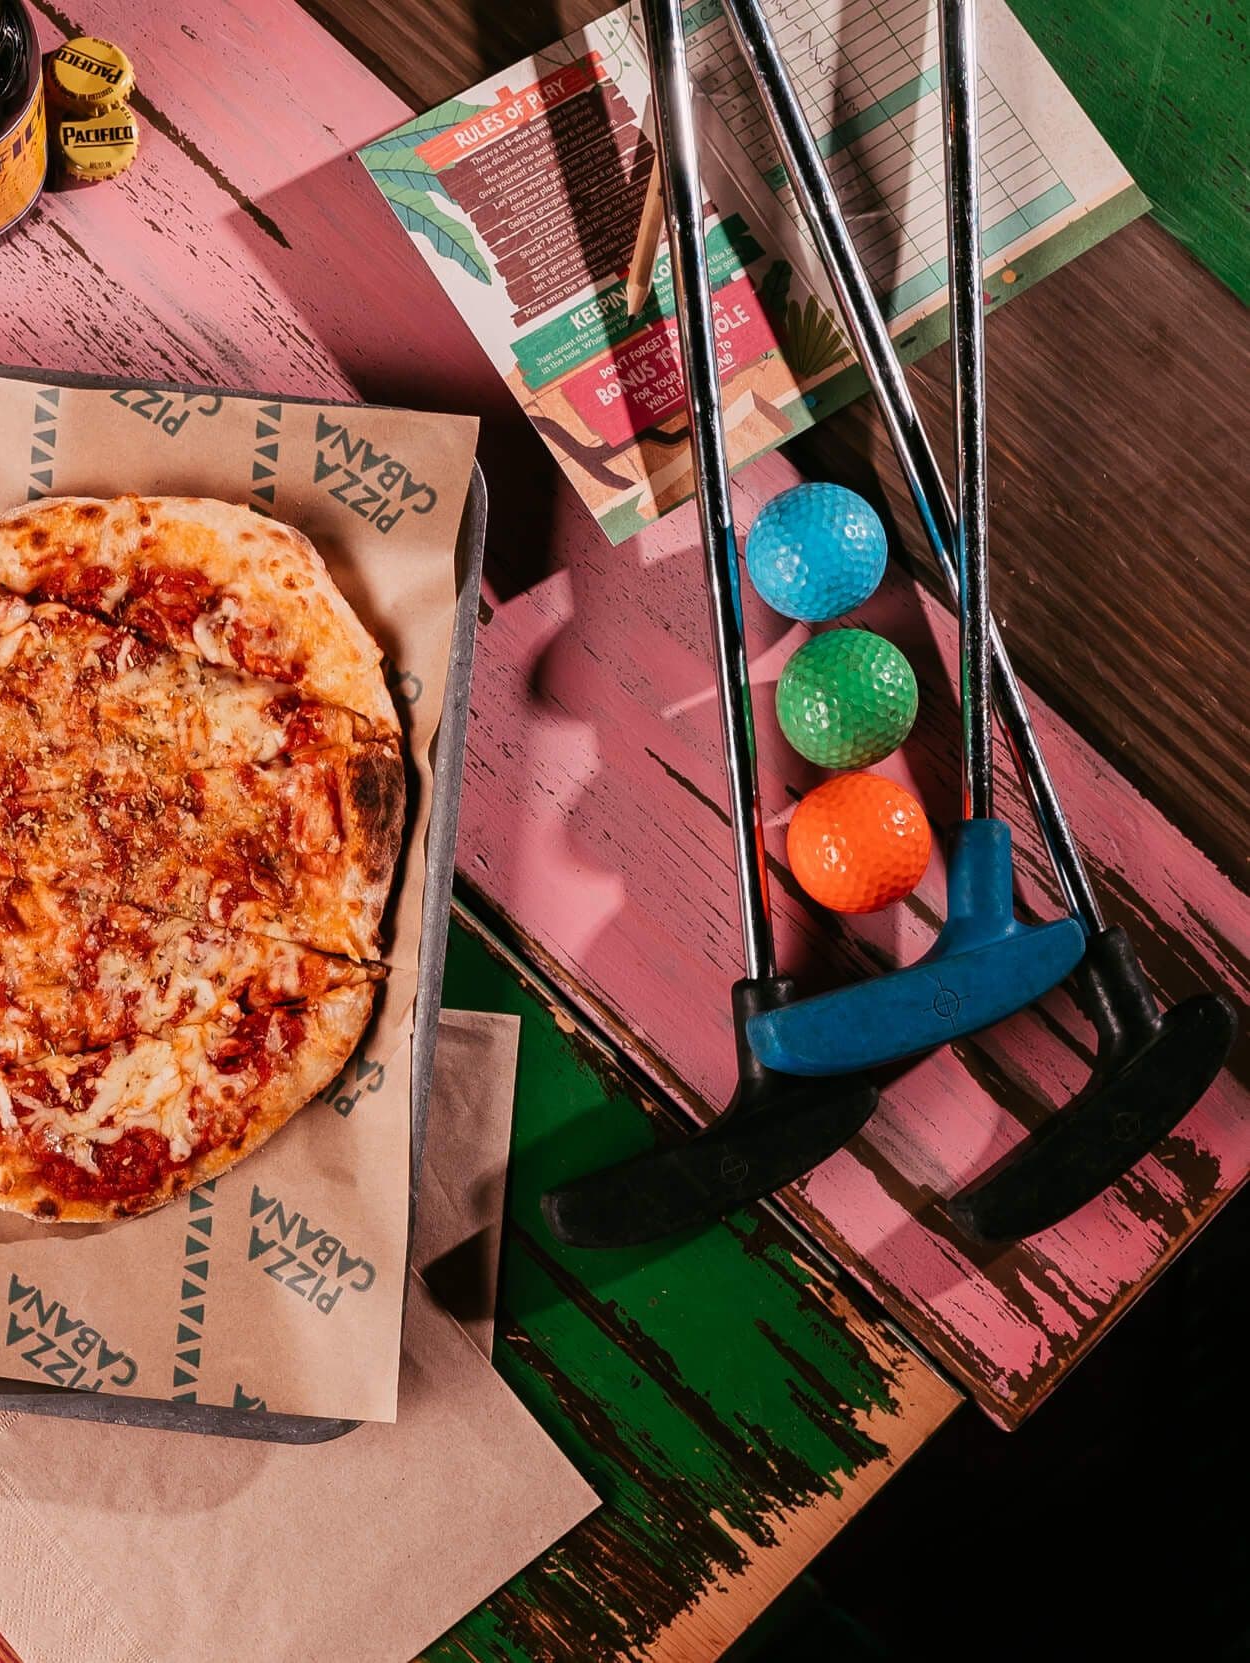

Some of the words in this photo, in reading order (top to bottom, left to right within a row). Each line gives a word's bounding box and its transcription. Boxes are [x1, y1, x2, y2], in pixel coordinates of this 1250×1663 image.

[453, 110, 506, 150] RULES
[502, 99, 526, 122] OF
[525, 76, 568, 109] PLAY
[528, 117, 549, 133] limit
[62, 126, 134, 145] PACIFICO
[475, 161, 493, 177] you
[509, 140, 529, 155] hold
[526, 134, 541, 148] up
[483, 171, 500, 185] Not
[497, 158, 521, 177] holed
[518, 150, 535, 165] the
[532, 142, 551, 157] ball
[476, 183, 498, 200] Give
[494, 166, 529, 192] yourself
[533, 152, 556, 169] score
[491, 196, 509, 211] Let
[506, 187, 526, 204] your
[523, 173, 549, 192] whole
[506, 209, 538, 232] Golfing
[533, 193, 565, 217] groups
[508, 190, 541, 214] anyone
[537, 177, 563, 198] plays
[517, 238, 547, 260] Stuck?
[544, 226, 568, 244] Move
[527, 220, 550, 237] Love
[547, 211, 568, 228] your
[527, 251, 548, 267] (one
[545, 237, 572, 258] putter
[530, 267, 550, 283] Ball
[547, 258, 570, 276] gone
[531, 279, 548, 294] left
[545, 272, 561, 286] the
[558, 258, 587, 279] course
[522, 299, 547, 318] Move
[544, 289, 565, 305] onto
[561, 281, 578, 295] the
[568, 285, 631, 331] KEEPIN
[707, 302, 752, 339] OLE
[533, 350, 554, 367] Just
[551, 337, 576, 356] count
[574, 329, 590, 343] the
[597, 355, 630, 380] DON'T
[627, 334, 666, 361] FORGET
[663, 324, 680, 340] TO
[716, 337, 734, 354] TO
[538, 364, 551, 375] in
[547, 355, 564, 370] the
[592, 357, 660, 407] BONUS
[631, 384, 654, 404] FOR
[650, 368, 681, 391] YOUR
[644, 391, 669, 411] WIN
[110, 389, 191, 437] PIZZ
[315, 413, 439, 516] CABANA
[312, 451, 401, 534] PIZZA
[250, 1184, 376, 1294] CABANA
[247, 1226, 345, 1315] PIZZA
[8, 1273, 139, 1388] CABANA
